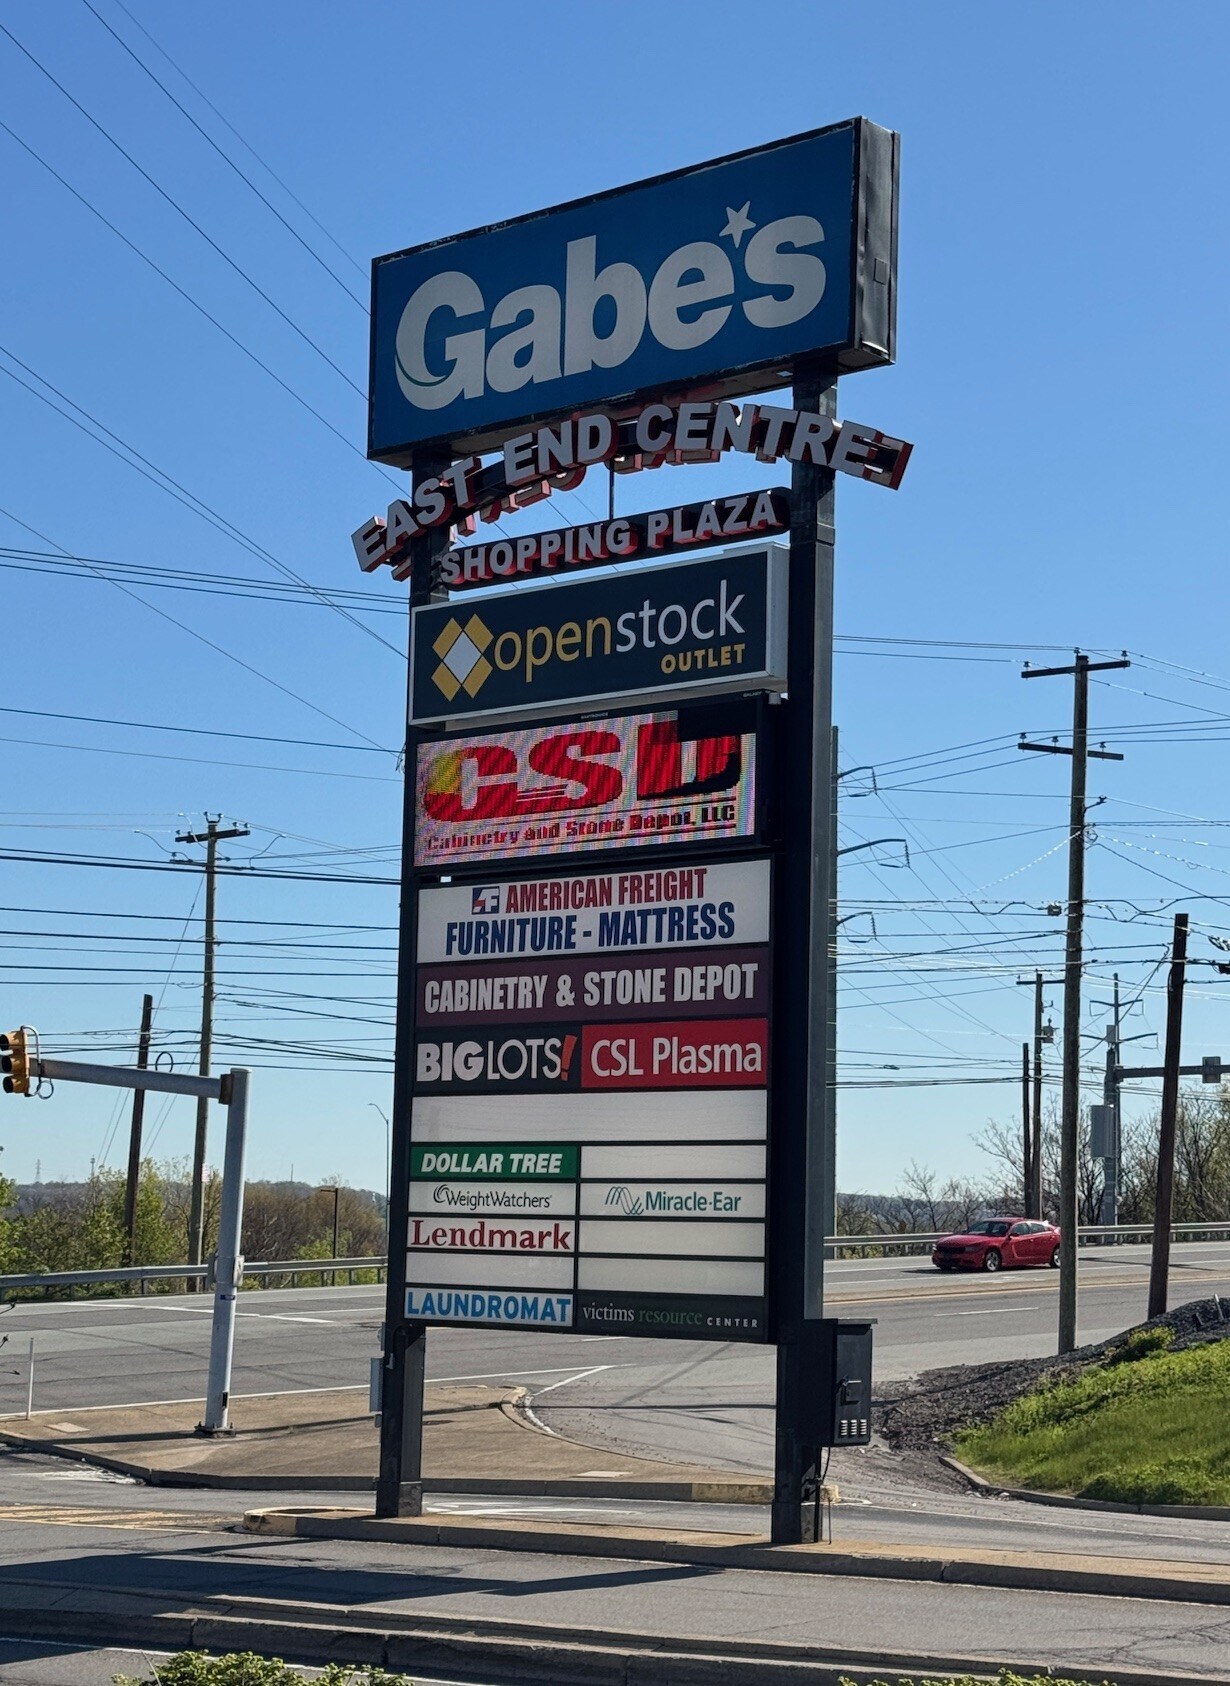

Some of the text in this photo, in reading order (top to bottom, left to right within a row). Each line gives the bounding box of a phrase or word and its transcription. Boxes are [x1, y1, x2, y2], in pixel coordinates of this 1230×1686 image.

[396, 201, 826, 410] Gabe's
[351, 402, 878, 573] EAST END CENTRE
[440, 492, 777, 584] SHOPPING PLAZA
[494, 579, 746, 682] openstock
[661, 643, 746, 675] OUTLET
[524, 822, 560, 841] and
[702, 805, 735, 823] LLC
[506, 876, 612, 913] AMERICAN
[619, 868, 708, 904] FREIGHT
[445, 914, 577, 956] FURNITURE
[598, 901, 735, 948] MATTRESS
[424, 963, 759, 1014] CABINETRY & STONE DEPOT
[591, 1036, 762, 1077] CSL Plasma
[421, 1153, 563, 1174] DOLLAR TREE
[410, 1219, 571, 1250] Lendmark
[407, 1291, 571, 1323] LAUNDROMAT
[583, 1302, 758, 1328] victims resource CENTER
